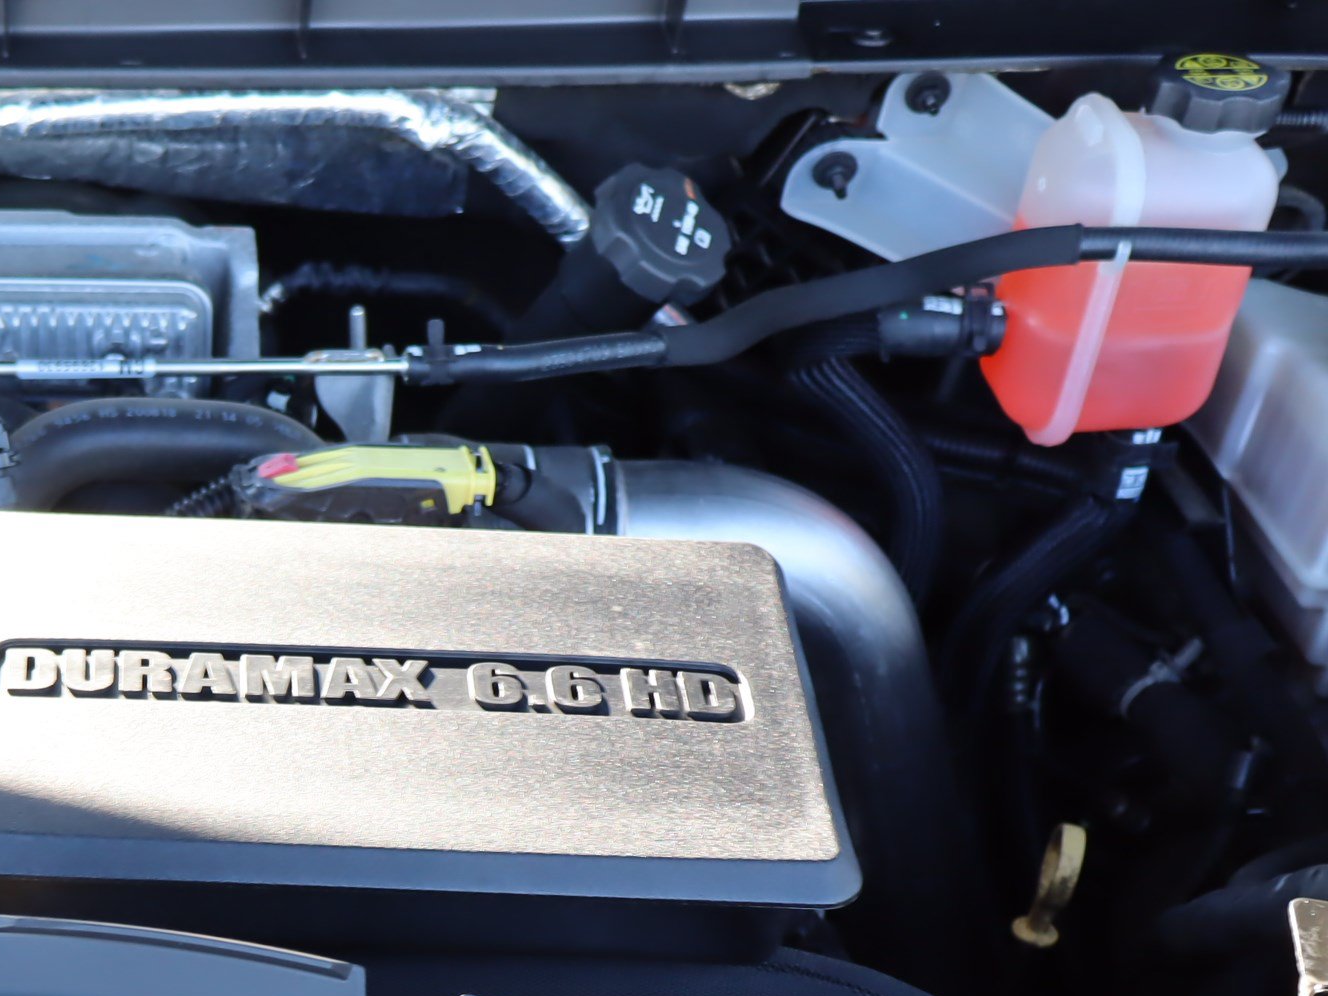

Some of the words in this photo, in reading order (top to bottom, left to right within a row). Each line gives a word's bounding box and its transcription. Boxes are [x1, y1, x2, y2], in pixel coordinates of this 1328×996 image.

[0, 647, 434, 706] DURAMAX
[467, 662, 609, 714] 6.6
[620, 667, 748, 721] HD
